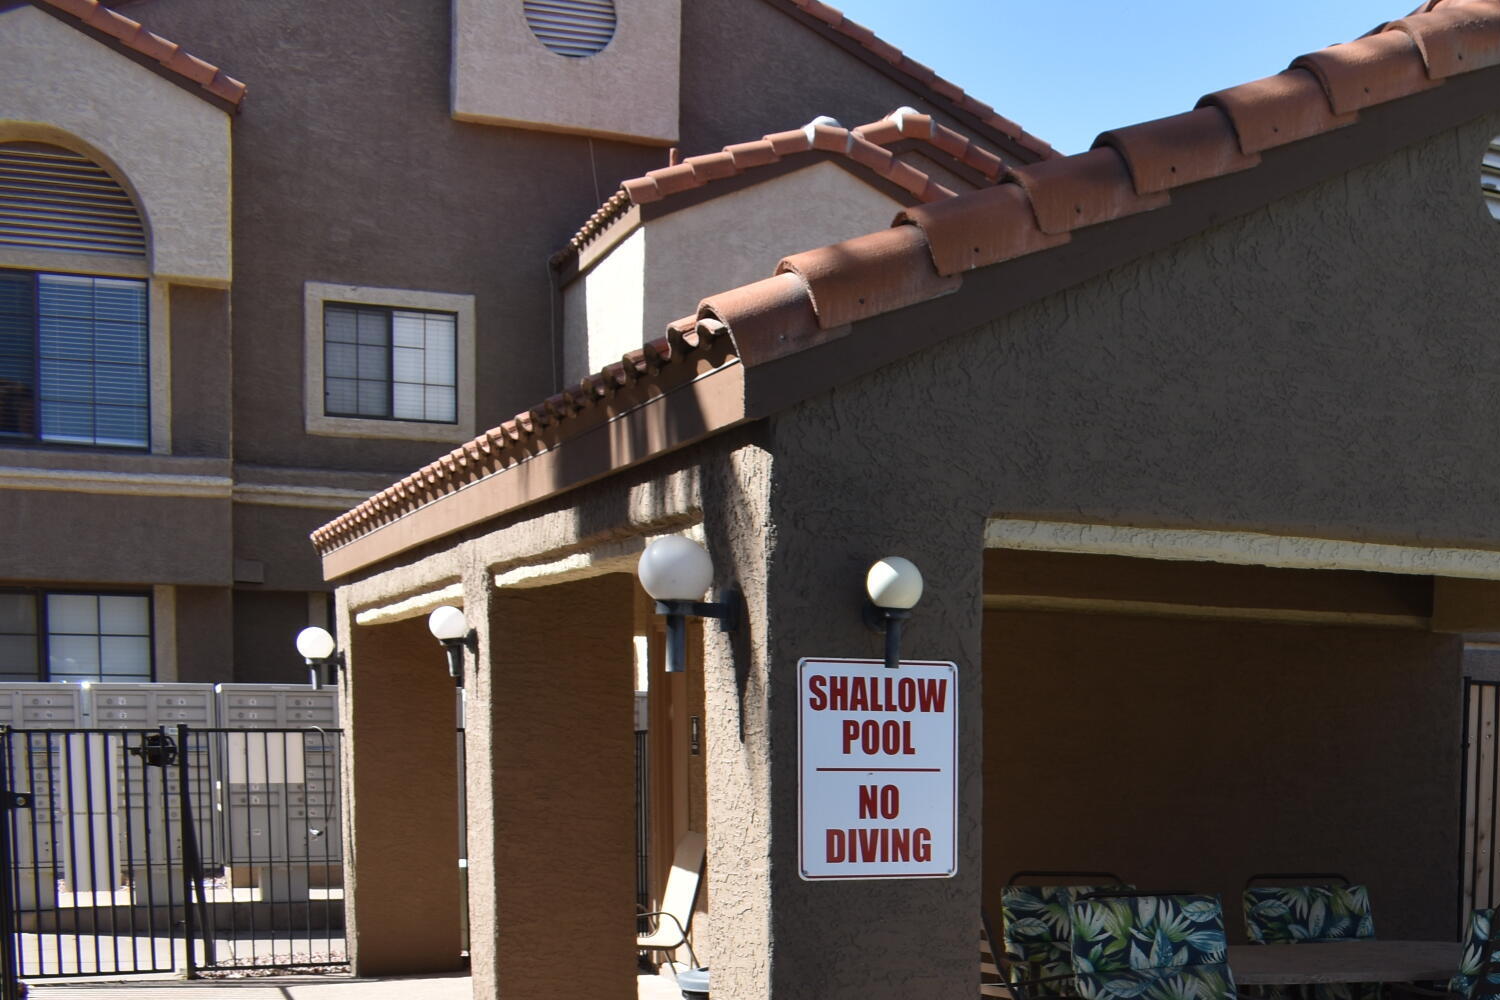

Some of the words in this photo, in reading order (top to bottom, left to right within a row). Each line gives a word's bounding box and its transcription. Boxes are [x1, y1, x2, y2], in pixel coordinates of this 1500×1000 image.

[809, 674, 947, 712] SHALLOW
[842, 719, 916, 755] POOL
[858, 784, 899, 819] NO
[826, 827, 932, 863] DIVING
